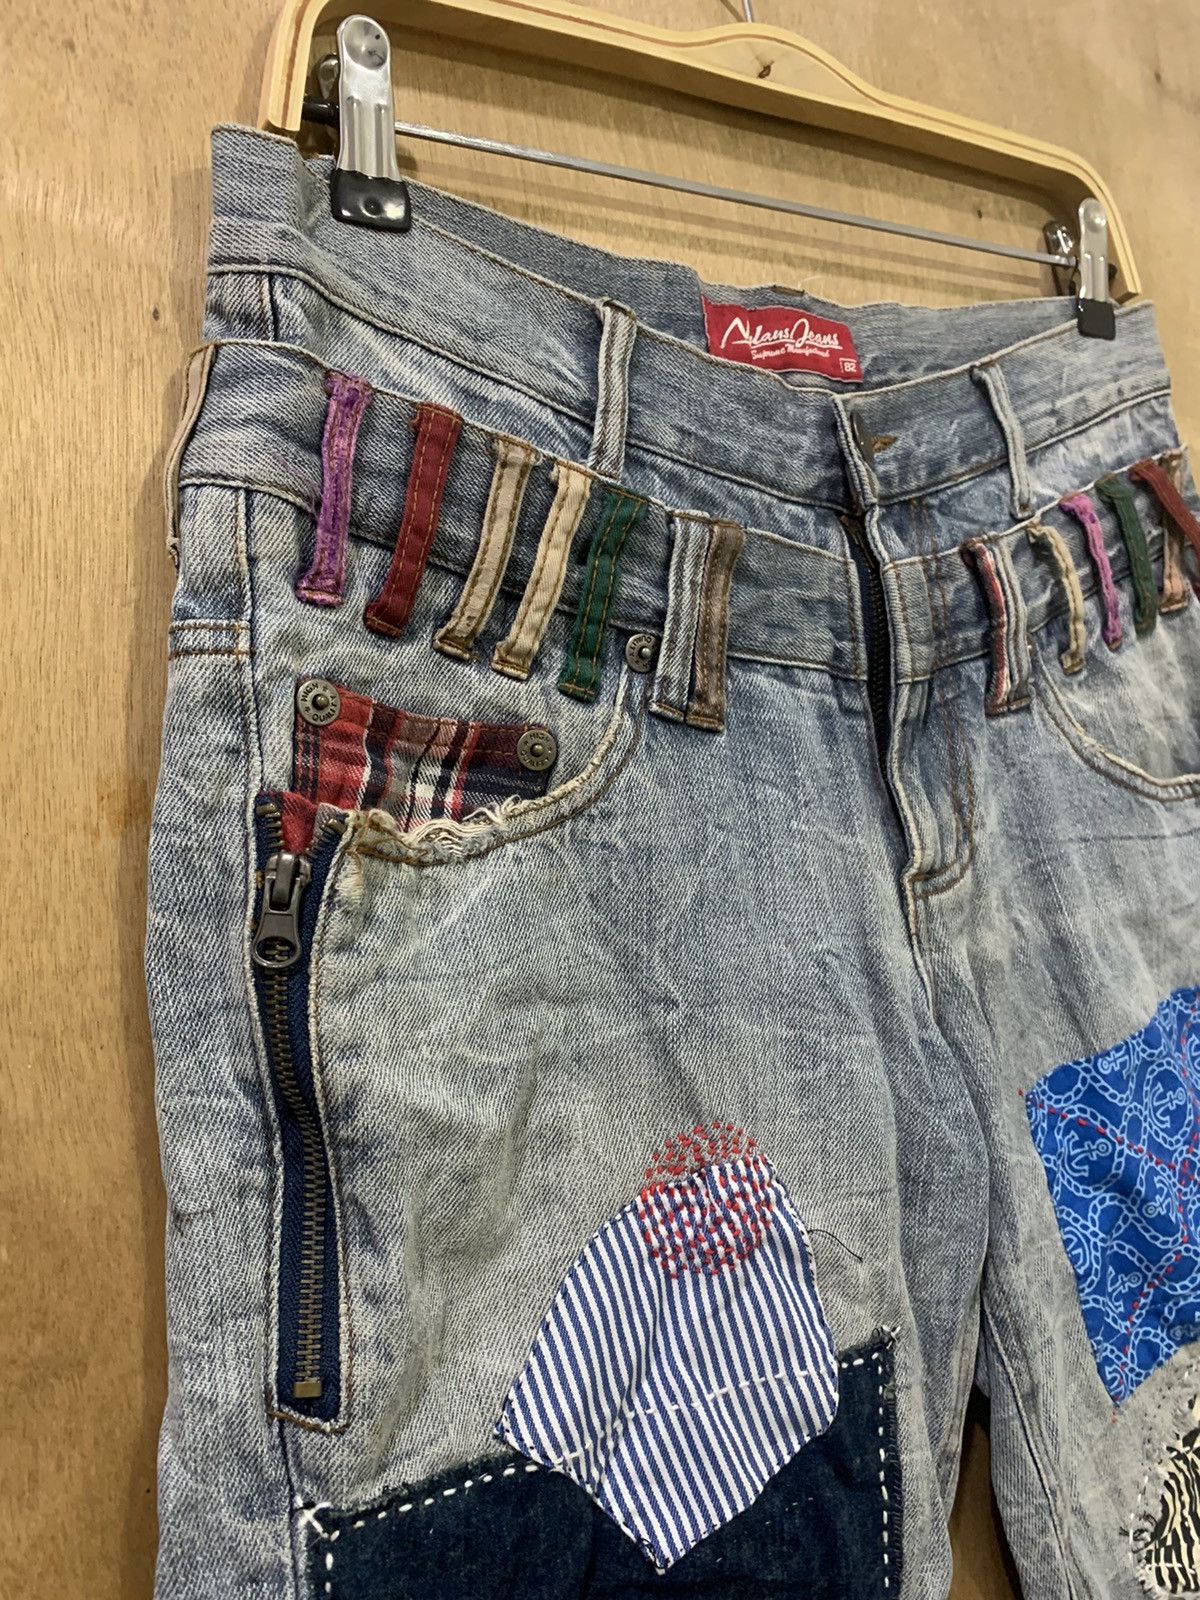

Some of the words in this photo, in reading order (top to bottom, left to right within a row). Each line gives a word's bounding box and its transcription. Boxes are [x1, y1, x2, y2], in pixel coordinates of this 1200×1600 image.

[790, 318, 842, 348] Jeans
[843, 362, 857, 373] 82
[300, 682, 319, 702] HIGH
[312, 695, 337, 722] QUALITY
